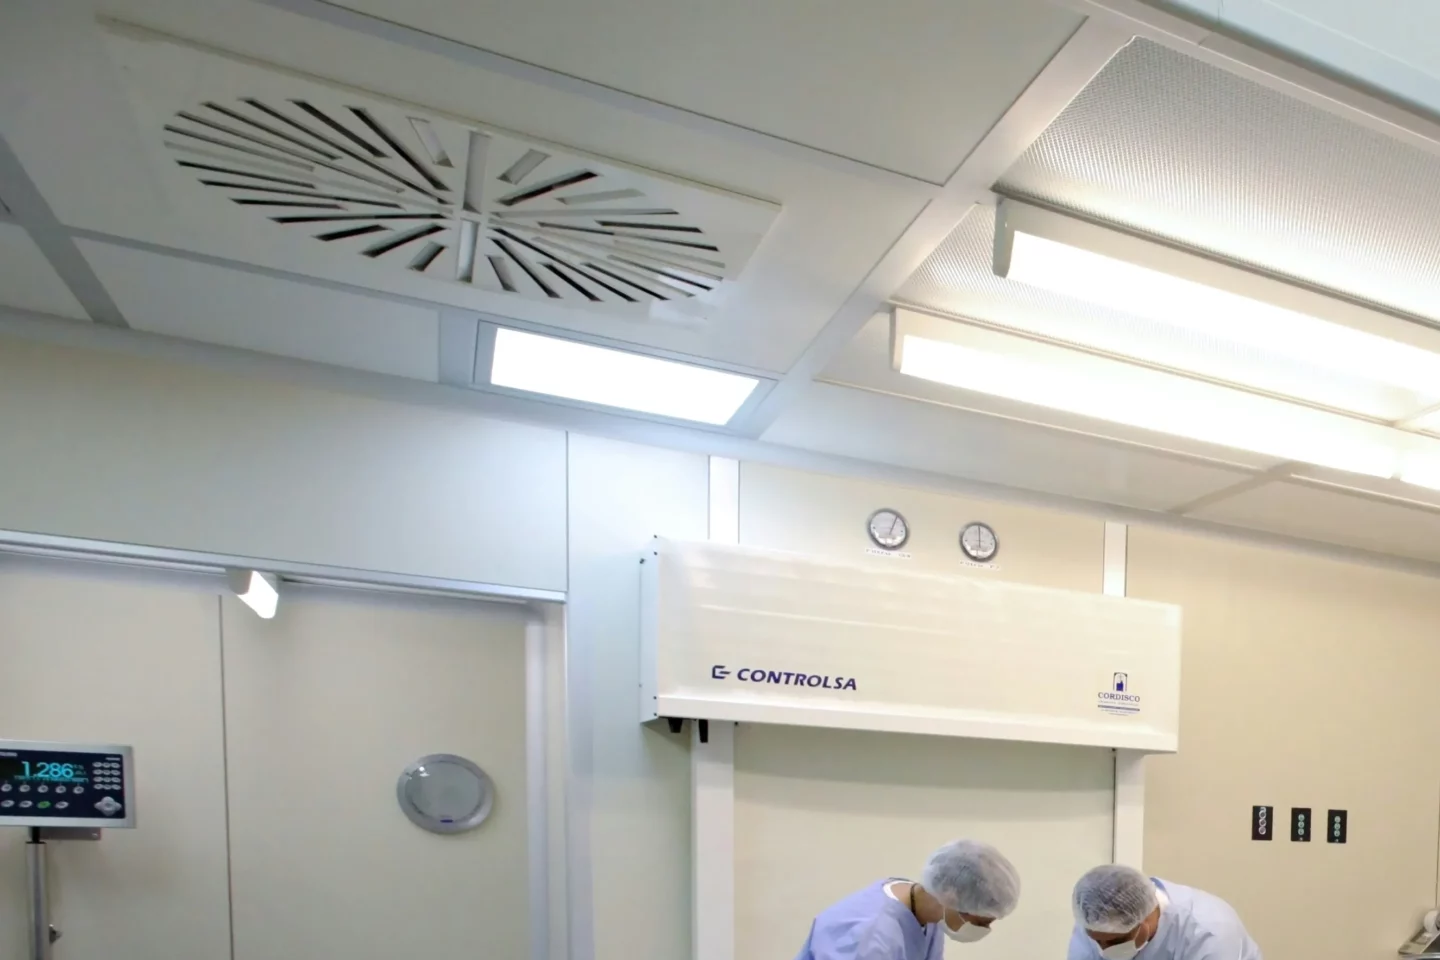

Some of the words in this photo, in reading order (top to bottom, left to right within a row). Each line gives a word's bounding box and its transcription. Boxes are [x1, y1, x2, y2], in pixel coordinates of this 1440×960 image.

[737, 668, 857, 691] CONTROLSA
[1097, 692, 1141, 703] CORDISCO
[21, 761, 74, 778] 1.286
